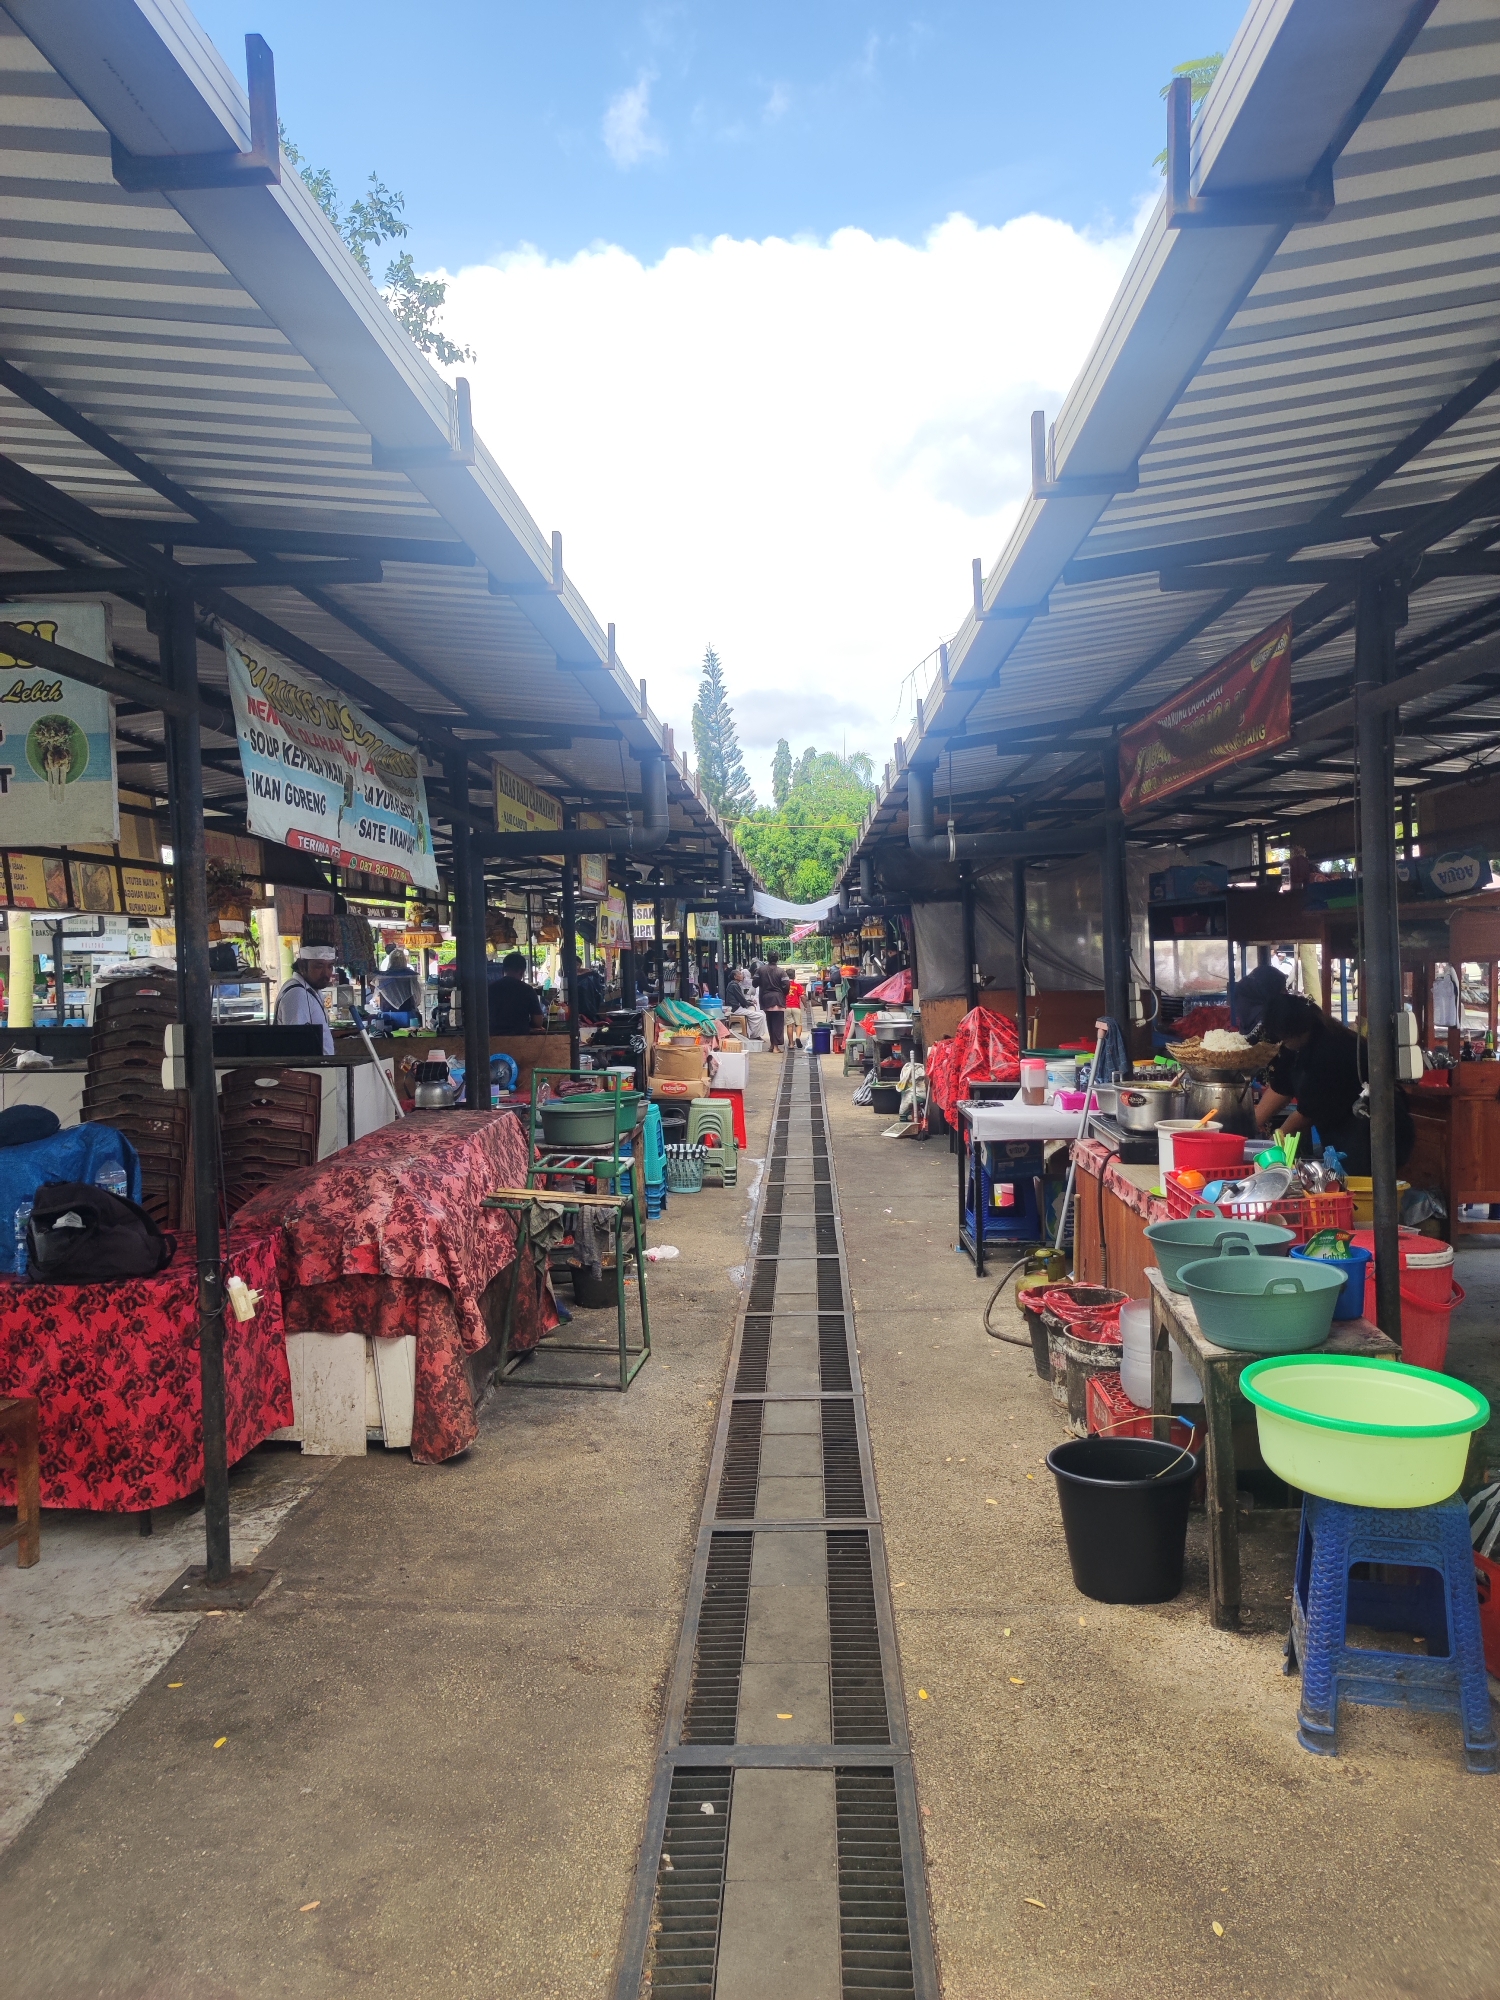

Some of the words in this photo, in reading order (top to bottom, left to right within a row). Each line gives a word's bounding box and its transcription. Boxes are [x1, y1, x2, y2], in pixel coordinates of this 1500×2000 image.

[2, 679, 63, 702] Lebih
[250, 728, 279, 759] SOUP
[252, 771, 280, 802] IKAN
[285, 783, 326, 816] GORENG
[359, 819, 386, 843] SATE
[298, 836, 329, 854] TERIMA
[1437, 865, 1473, 885] AQUA
